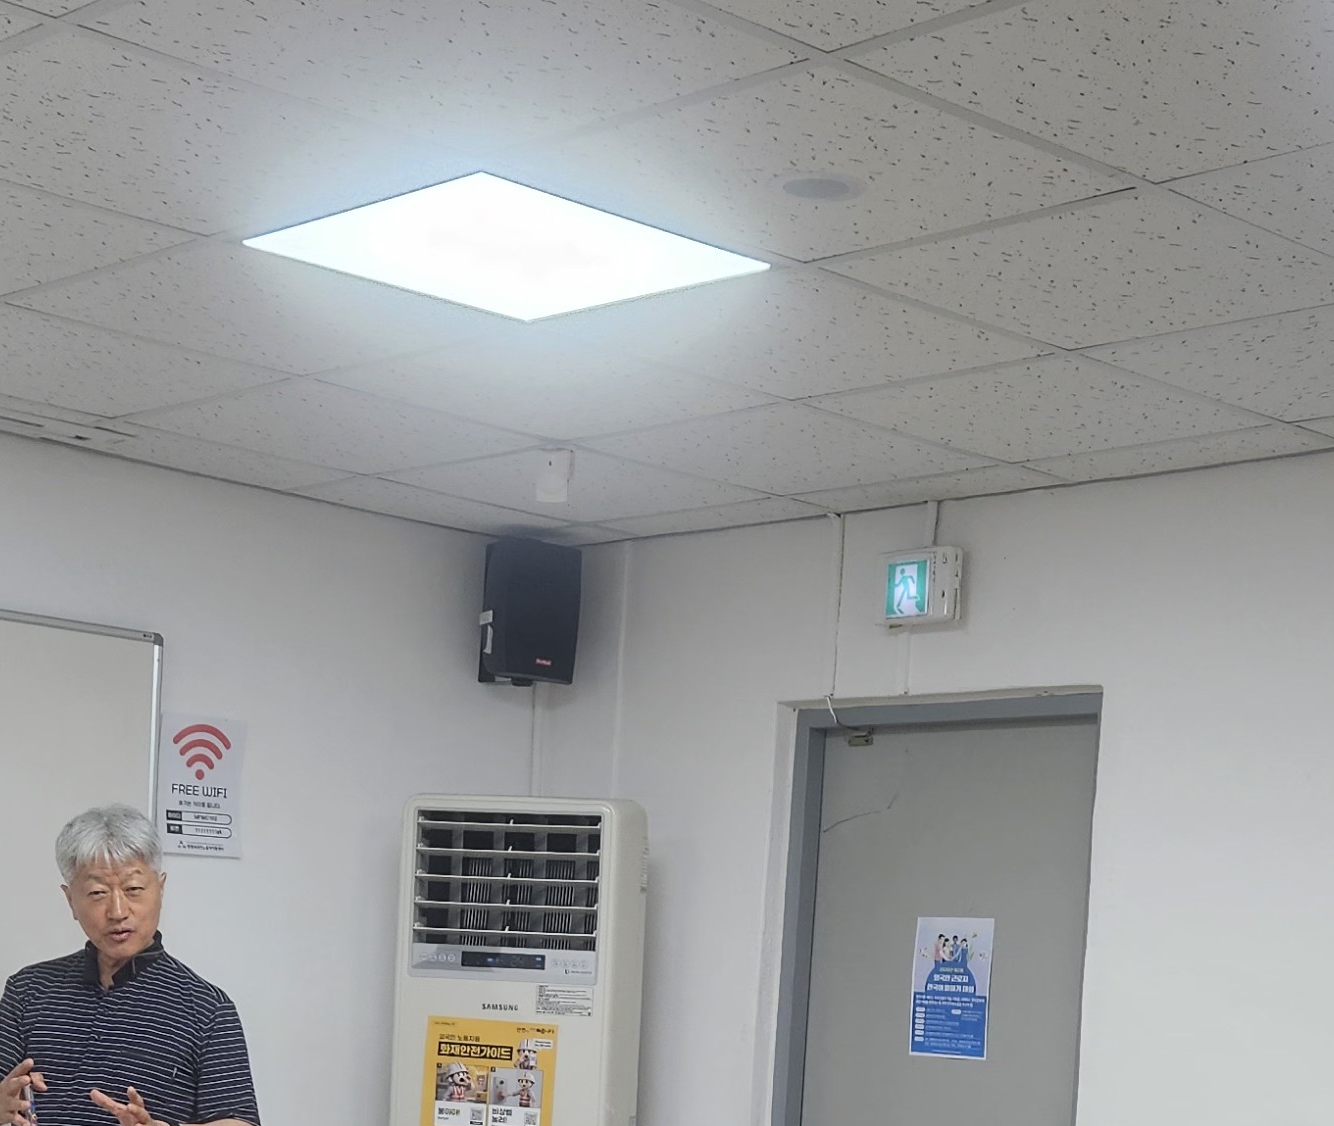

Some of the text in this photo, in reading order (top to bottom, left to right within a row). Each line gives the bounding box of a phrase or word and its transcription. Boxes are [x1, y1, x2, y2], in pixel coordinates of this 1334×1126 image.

[171, 783, 227, 799] FREE WIFI
[482, 1003, 519, 1012] SAMSUNG
[439, 1043, 511, 1060] 화재안전가이드
